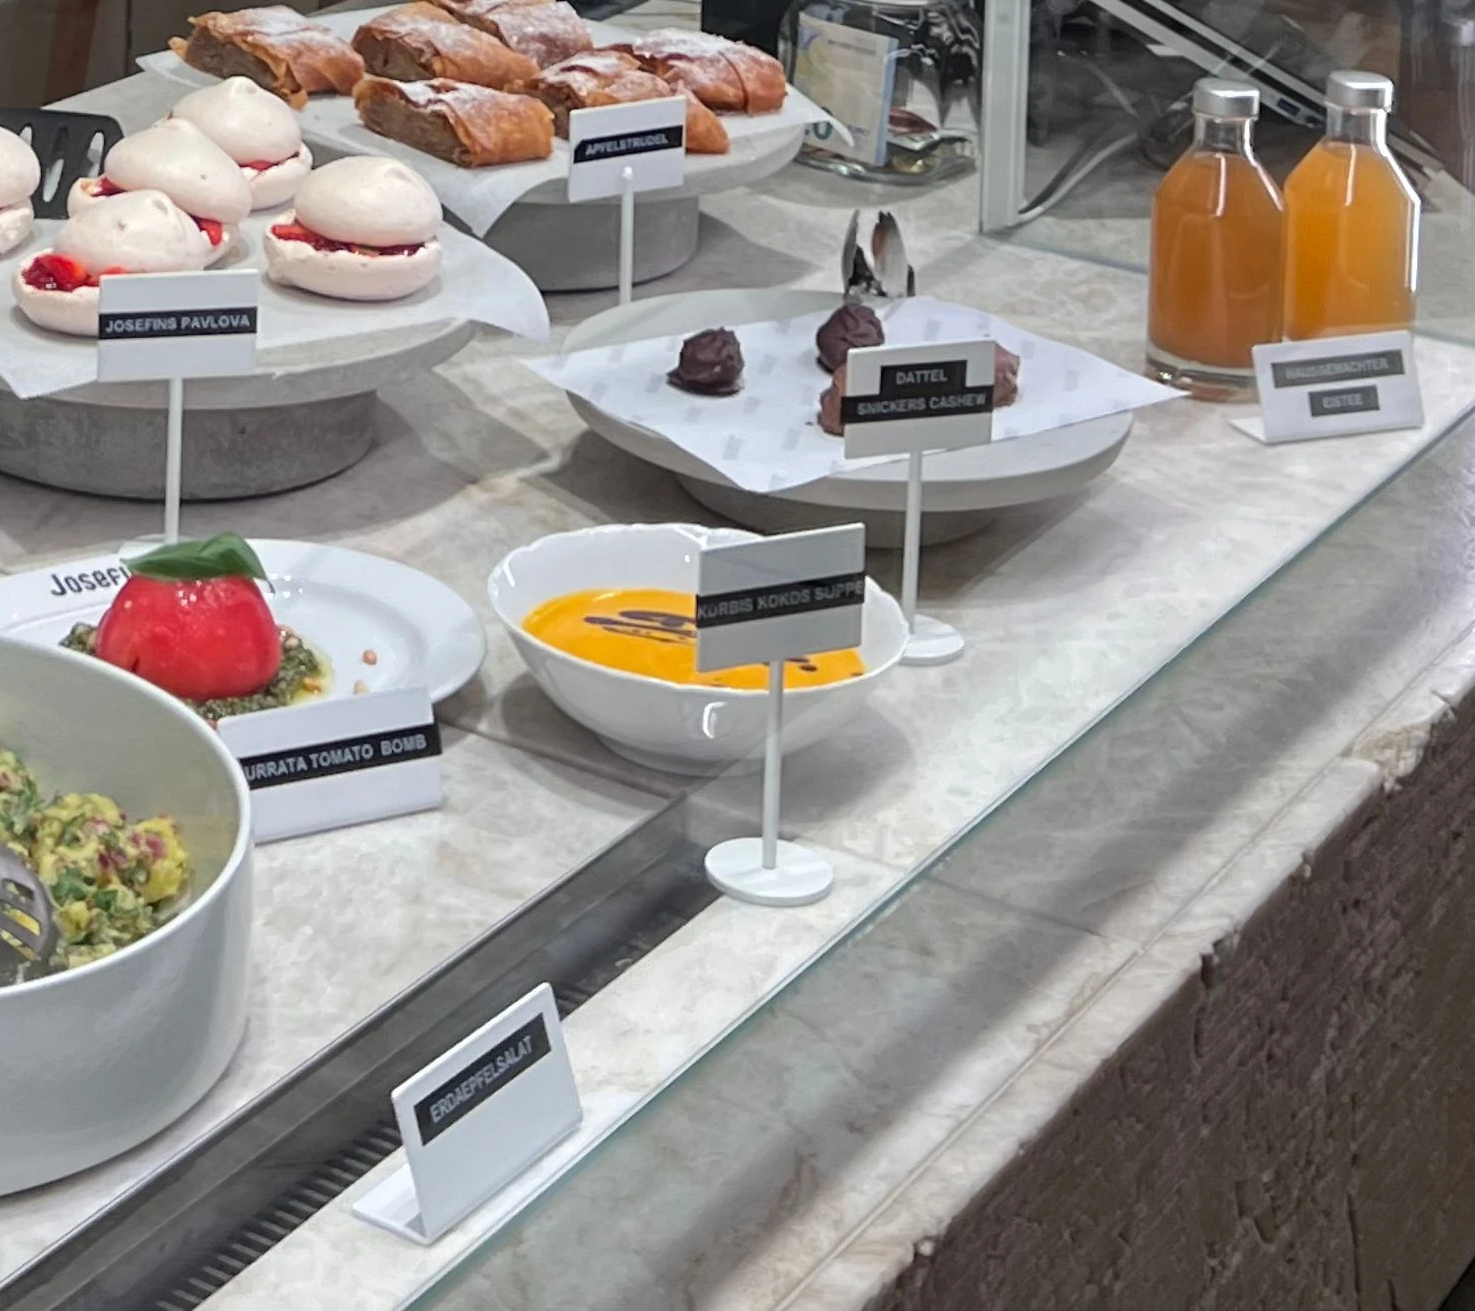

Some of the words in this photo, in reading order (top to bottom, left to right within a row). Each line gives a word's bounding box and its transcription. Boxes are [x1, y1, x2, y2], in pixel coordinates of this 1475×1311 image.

[105, 317, 176, 333] JOSEFINS
[181, 314, 250, 329] PAVLOVA
[895, 369, 948, 385] DATTEL
[857, 397, 926, 415] SNICKERS
[929, 393, 986, 409] CASHEW
[757, 589, 811, 610] KOKOS
[815, 580, 863, 601] SUPPE
[244, 756, 308, 780] URRATA
[310, 744, 374, 769] TOMATO
[380, 734, 426, 757] BOMB
